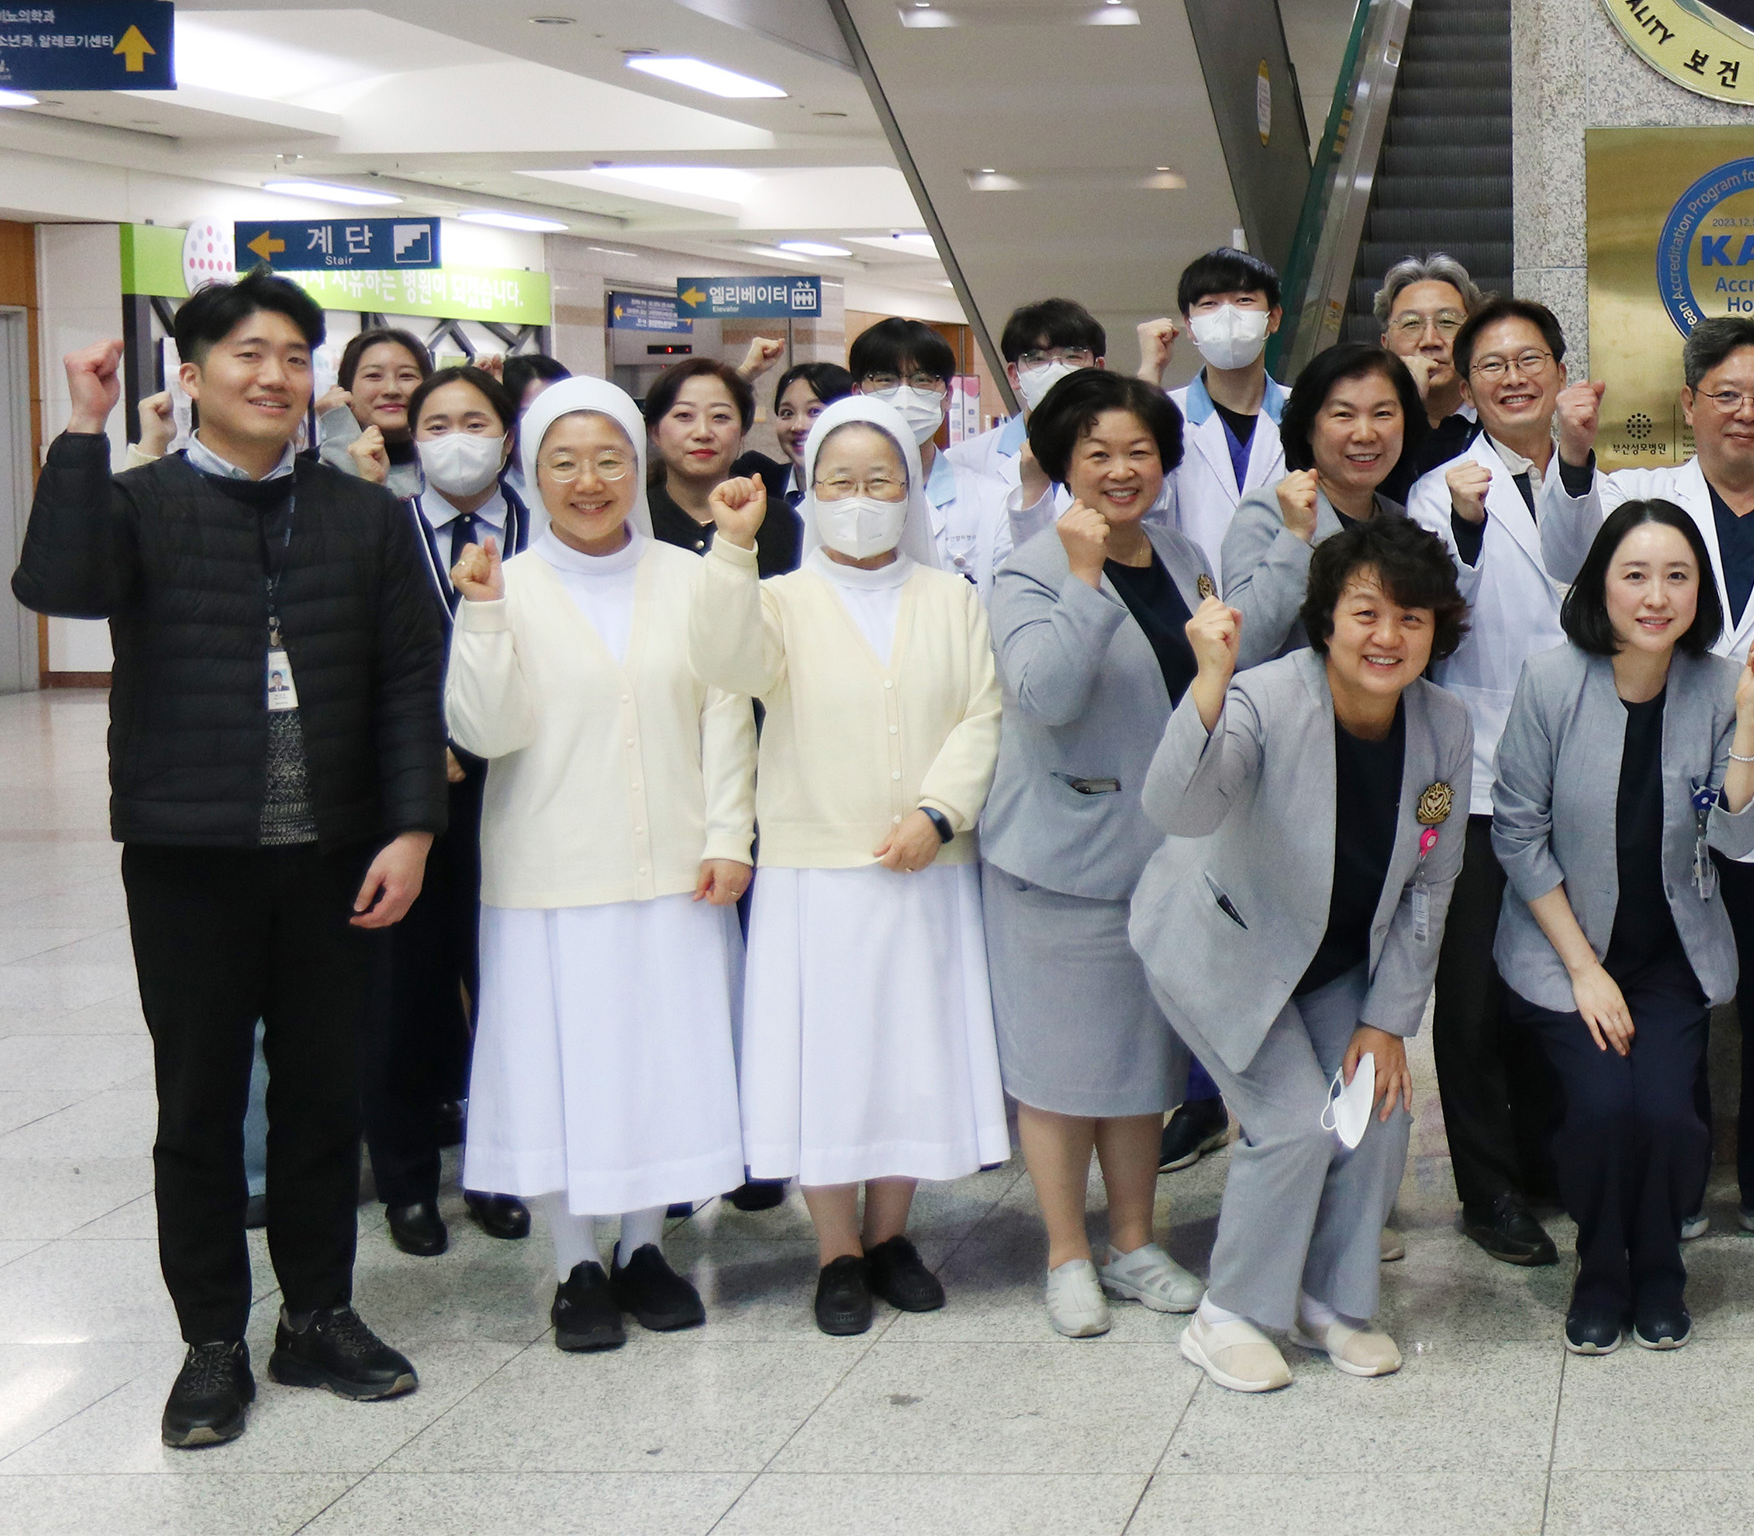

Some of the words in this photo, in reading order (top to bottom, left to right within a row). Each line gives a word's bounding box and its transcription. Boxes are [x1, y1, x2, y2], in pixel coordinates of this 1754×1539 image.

[1667, 214, 1694, 301] Accreditation
[1688, 173, 1741, 214] Program
[325, 255, 353, 265] Stair
[709, 285, 787, 305] 엘리베이터
[1612, 443, 1667, 455] 부산성모병원
